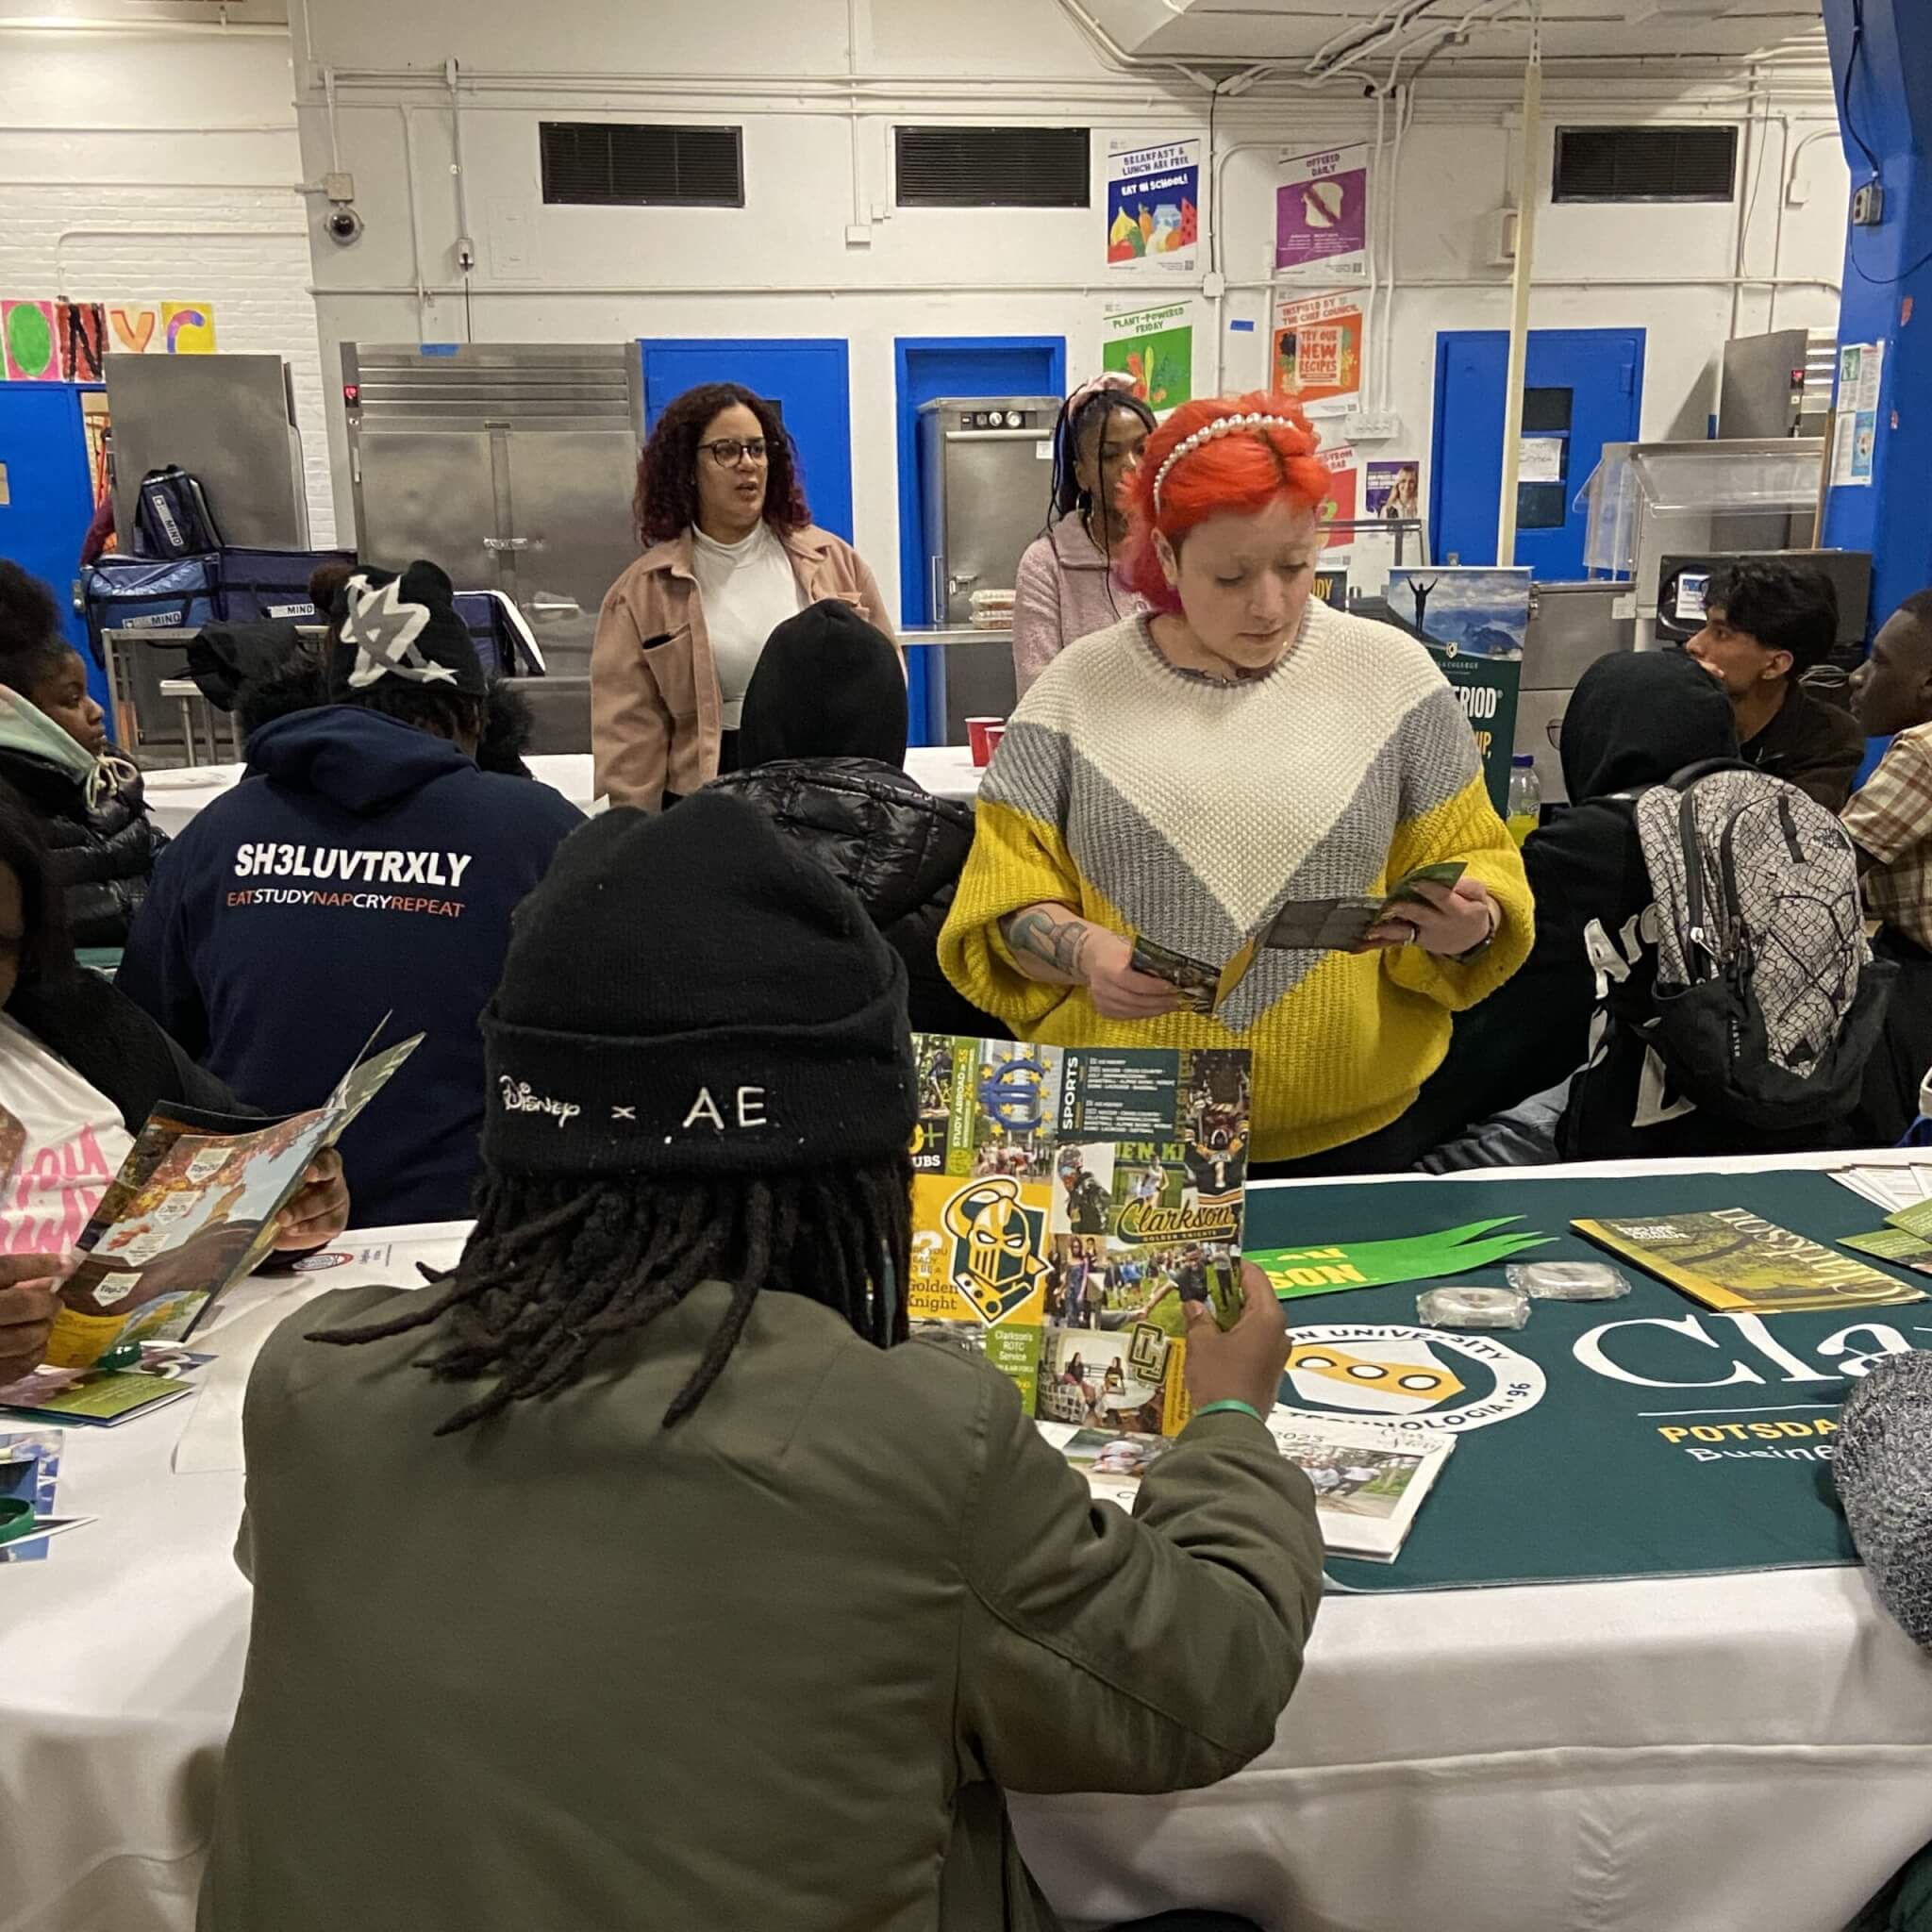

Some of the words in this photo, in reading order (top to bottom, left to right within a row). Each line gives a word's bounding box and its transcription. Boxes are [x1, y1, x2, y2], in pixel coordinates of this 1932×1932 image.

[1123, 163, 1151, 175] LUNCH
[1171, 156, 1190, 167] FREE
[1121, 184, 1137, 196] EAT
[1300, 343, 1337, 358] NEW
[1299, 360, 1337, 372] RECIPES
[235, 842, 472, 887] SH3LUVTRXLY
[1062, 1057, 1079, 1130] SPORTS
[1117, 1197, 1235, 1236] Clarkson
[1573, 1311, 1924, 1388] Cla
